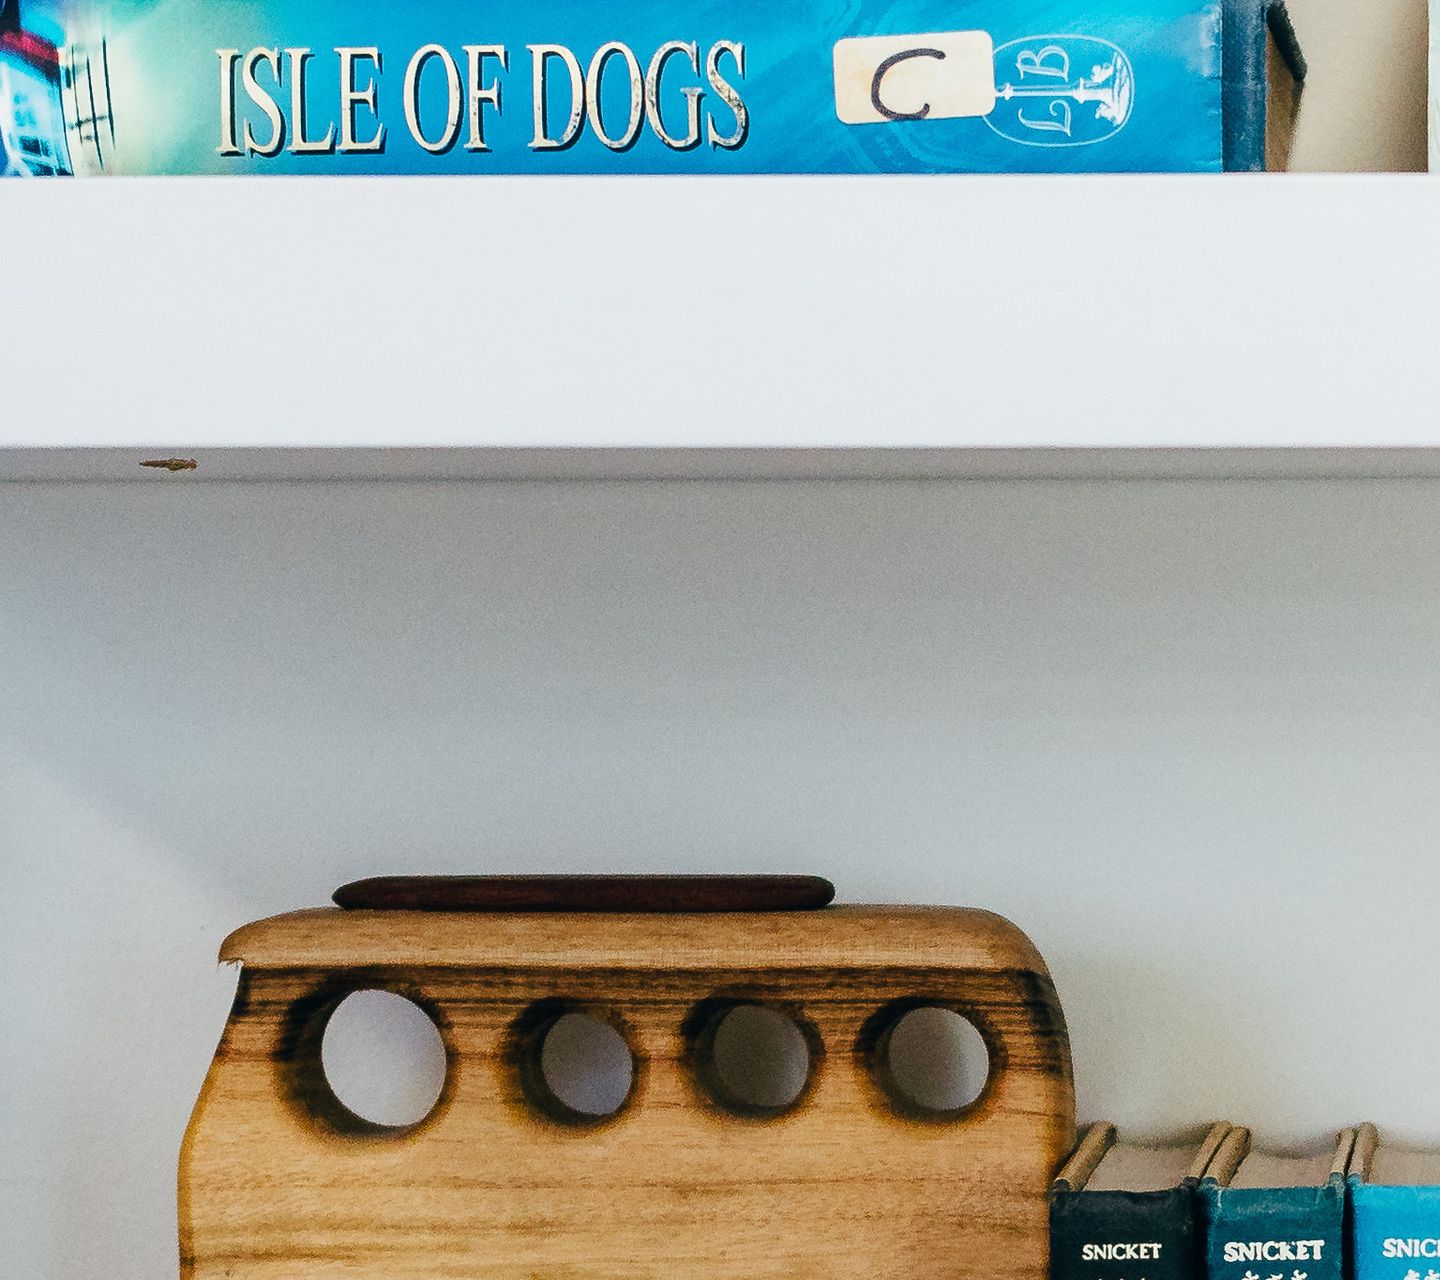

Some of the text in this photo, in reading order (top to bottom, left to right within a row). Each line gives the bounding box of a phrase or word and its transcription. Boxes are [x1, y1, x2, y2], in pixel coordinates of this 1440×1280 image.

[215, 40, 749, 156] ISLE OF DOGS
[871, 48, 946, 121] C
[1082, 1242, 1162, 1260] SNICKET
[1223, 1239, 1325, 1261] SNICKET
